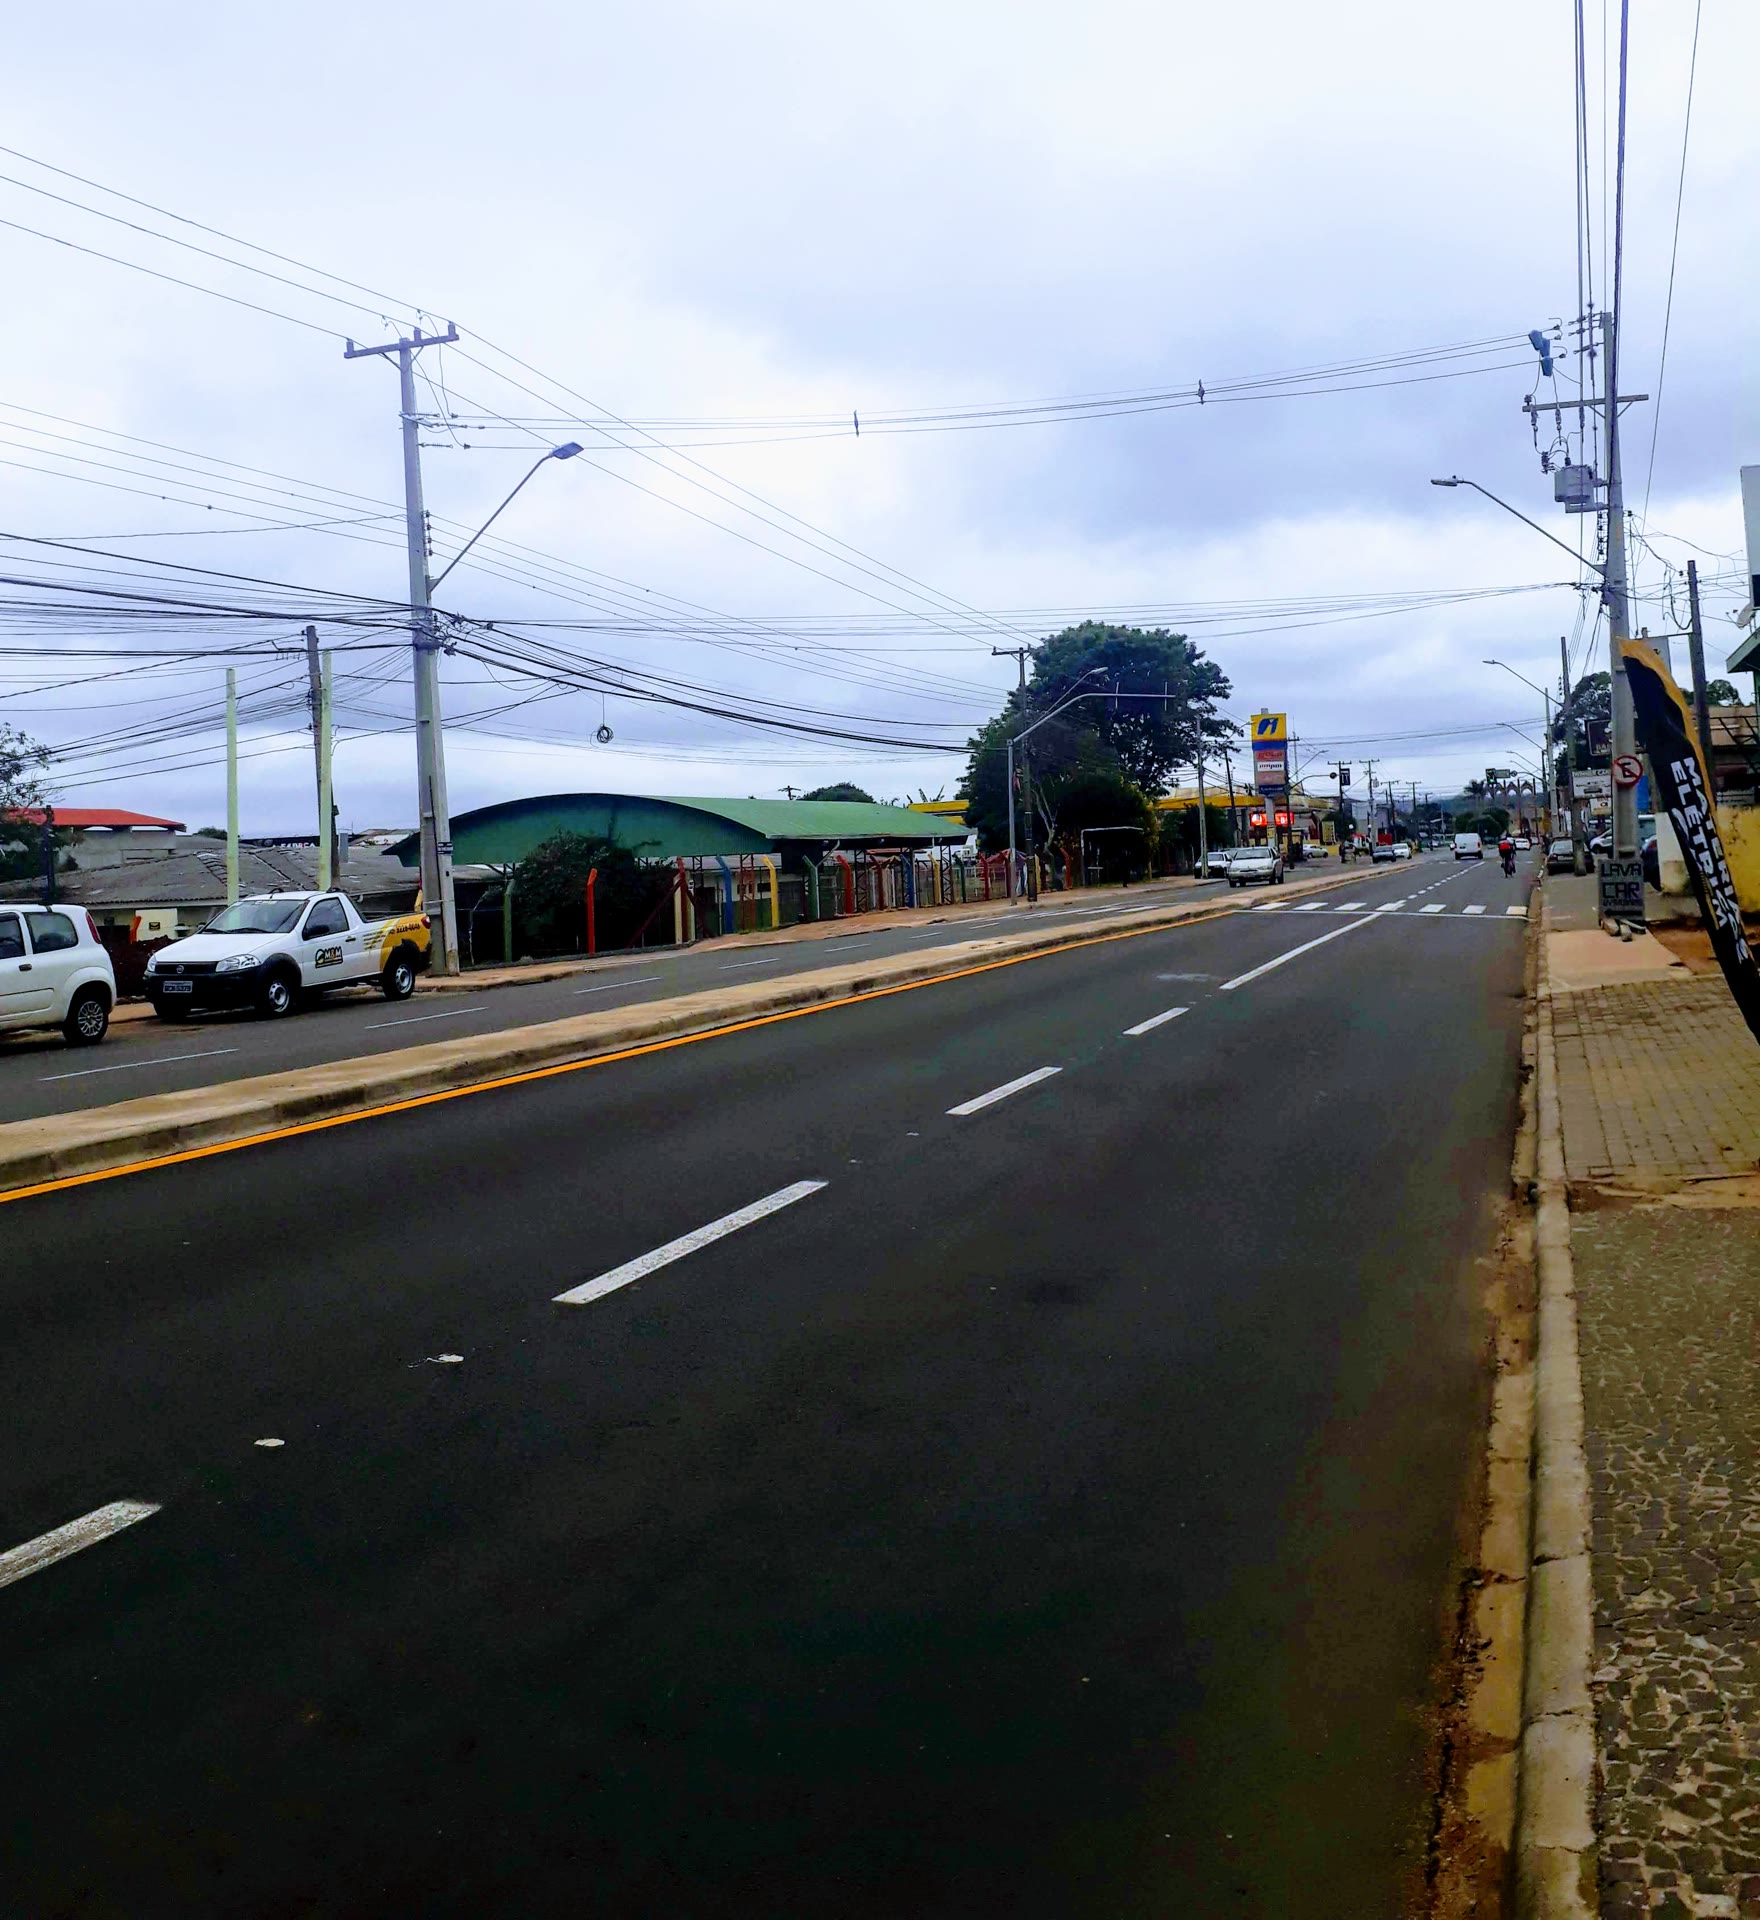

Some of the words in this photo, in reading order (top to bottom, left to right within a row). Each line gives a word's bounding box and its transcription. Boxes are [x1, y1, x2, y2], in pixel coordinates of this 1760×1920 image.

[1601, 863, 1642, 876] LAVA
[1602, 882, 1640, 899] CAR
[324, 946, 342, 959] M&M
